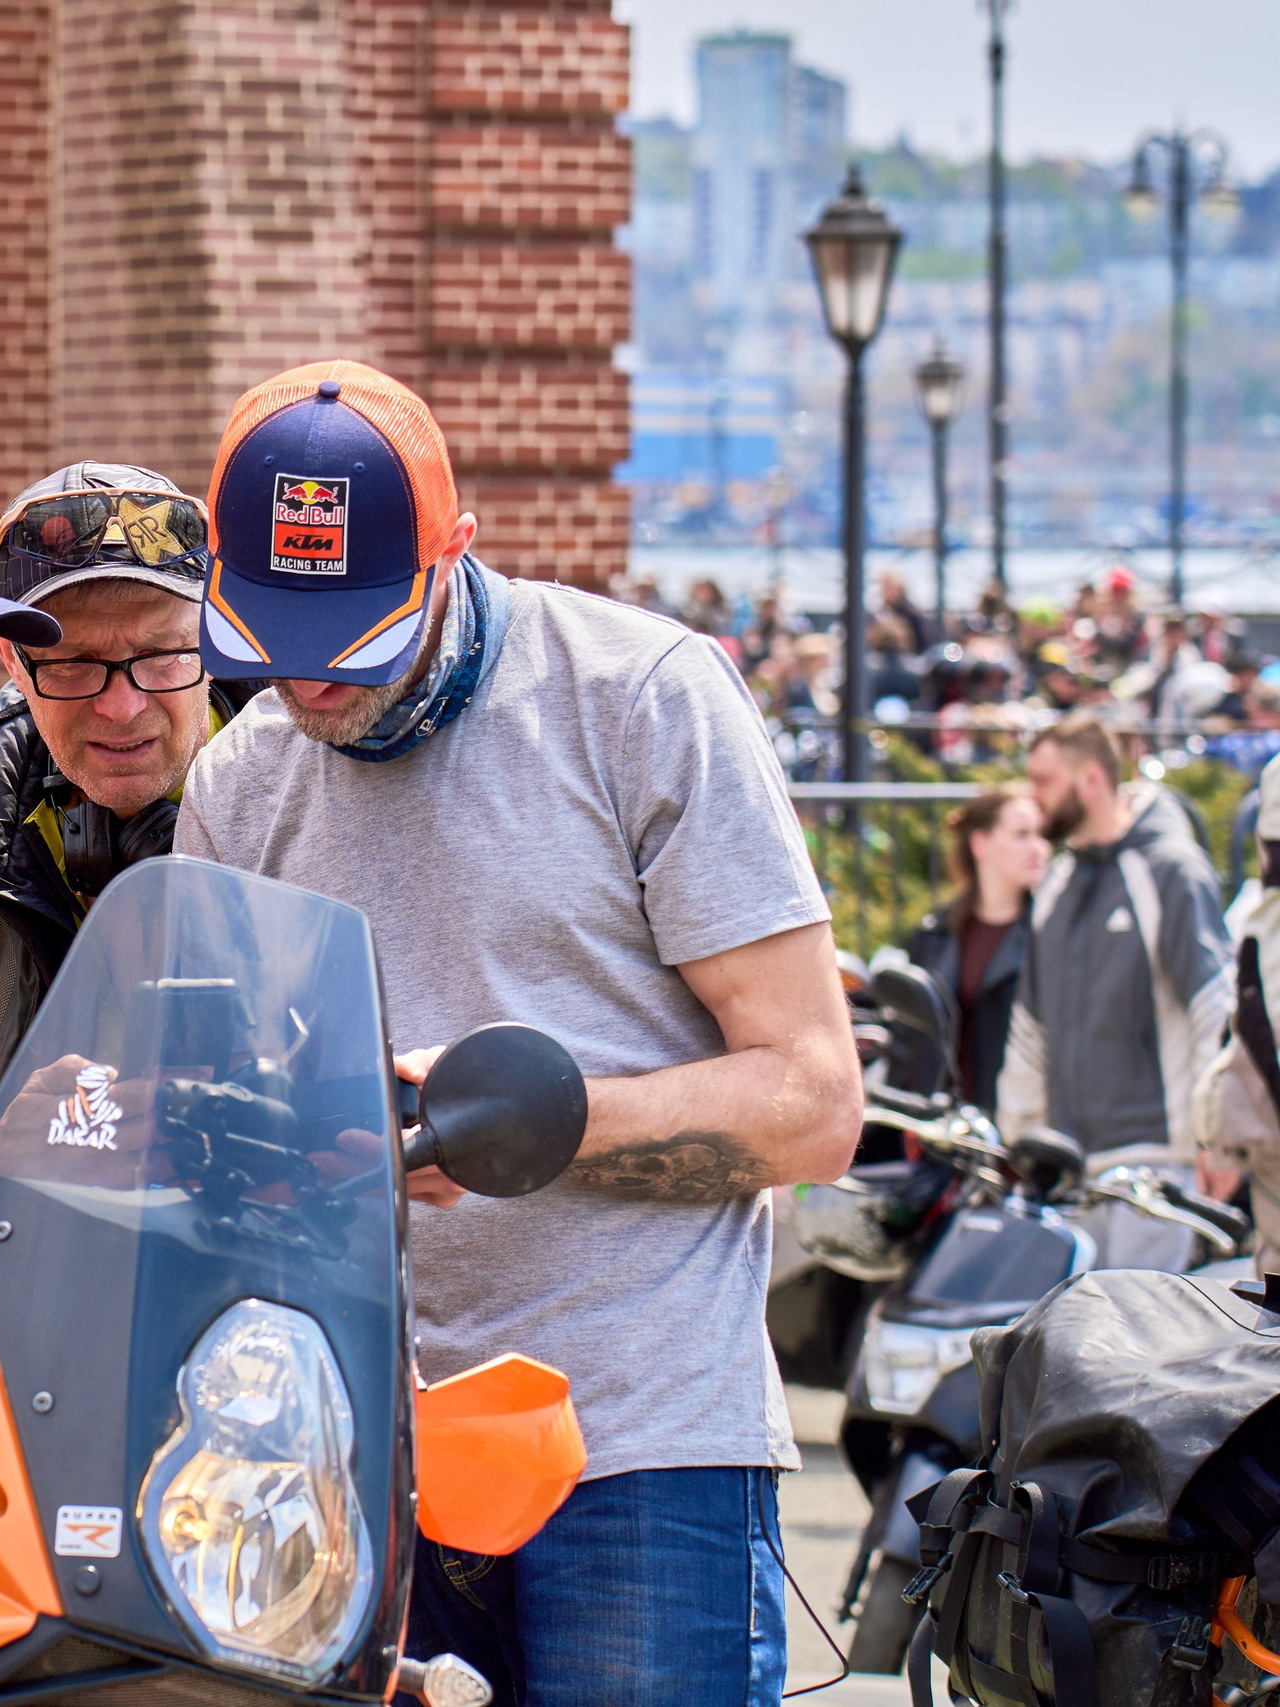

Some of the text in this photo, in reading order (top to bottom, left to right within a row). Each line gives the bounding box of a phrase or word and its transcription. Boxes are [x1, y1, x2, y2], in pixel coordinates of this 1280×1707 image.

[276, 502, 345, 525] Red Bull
[282, 533, 335, 551] KTM
[273, 555, 344, 571] RACING TEAM
[46, 1117, 119, 1151] DAKAR
